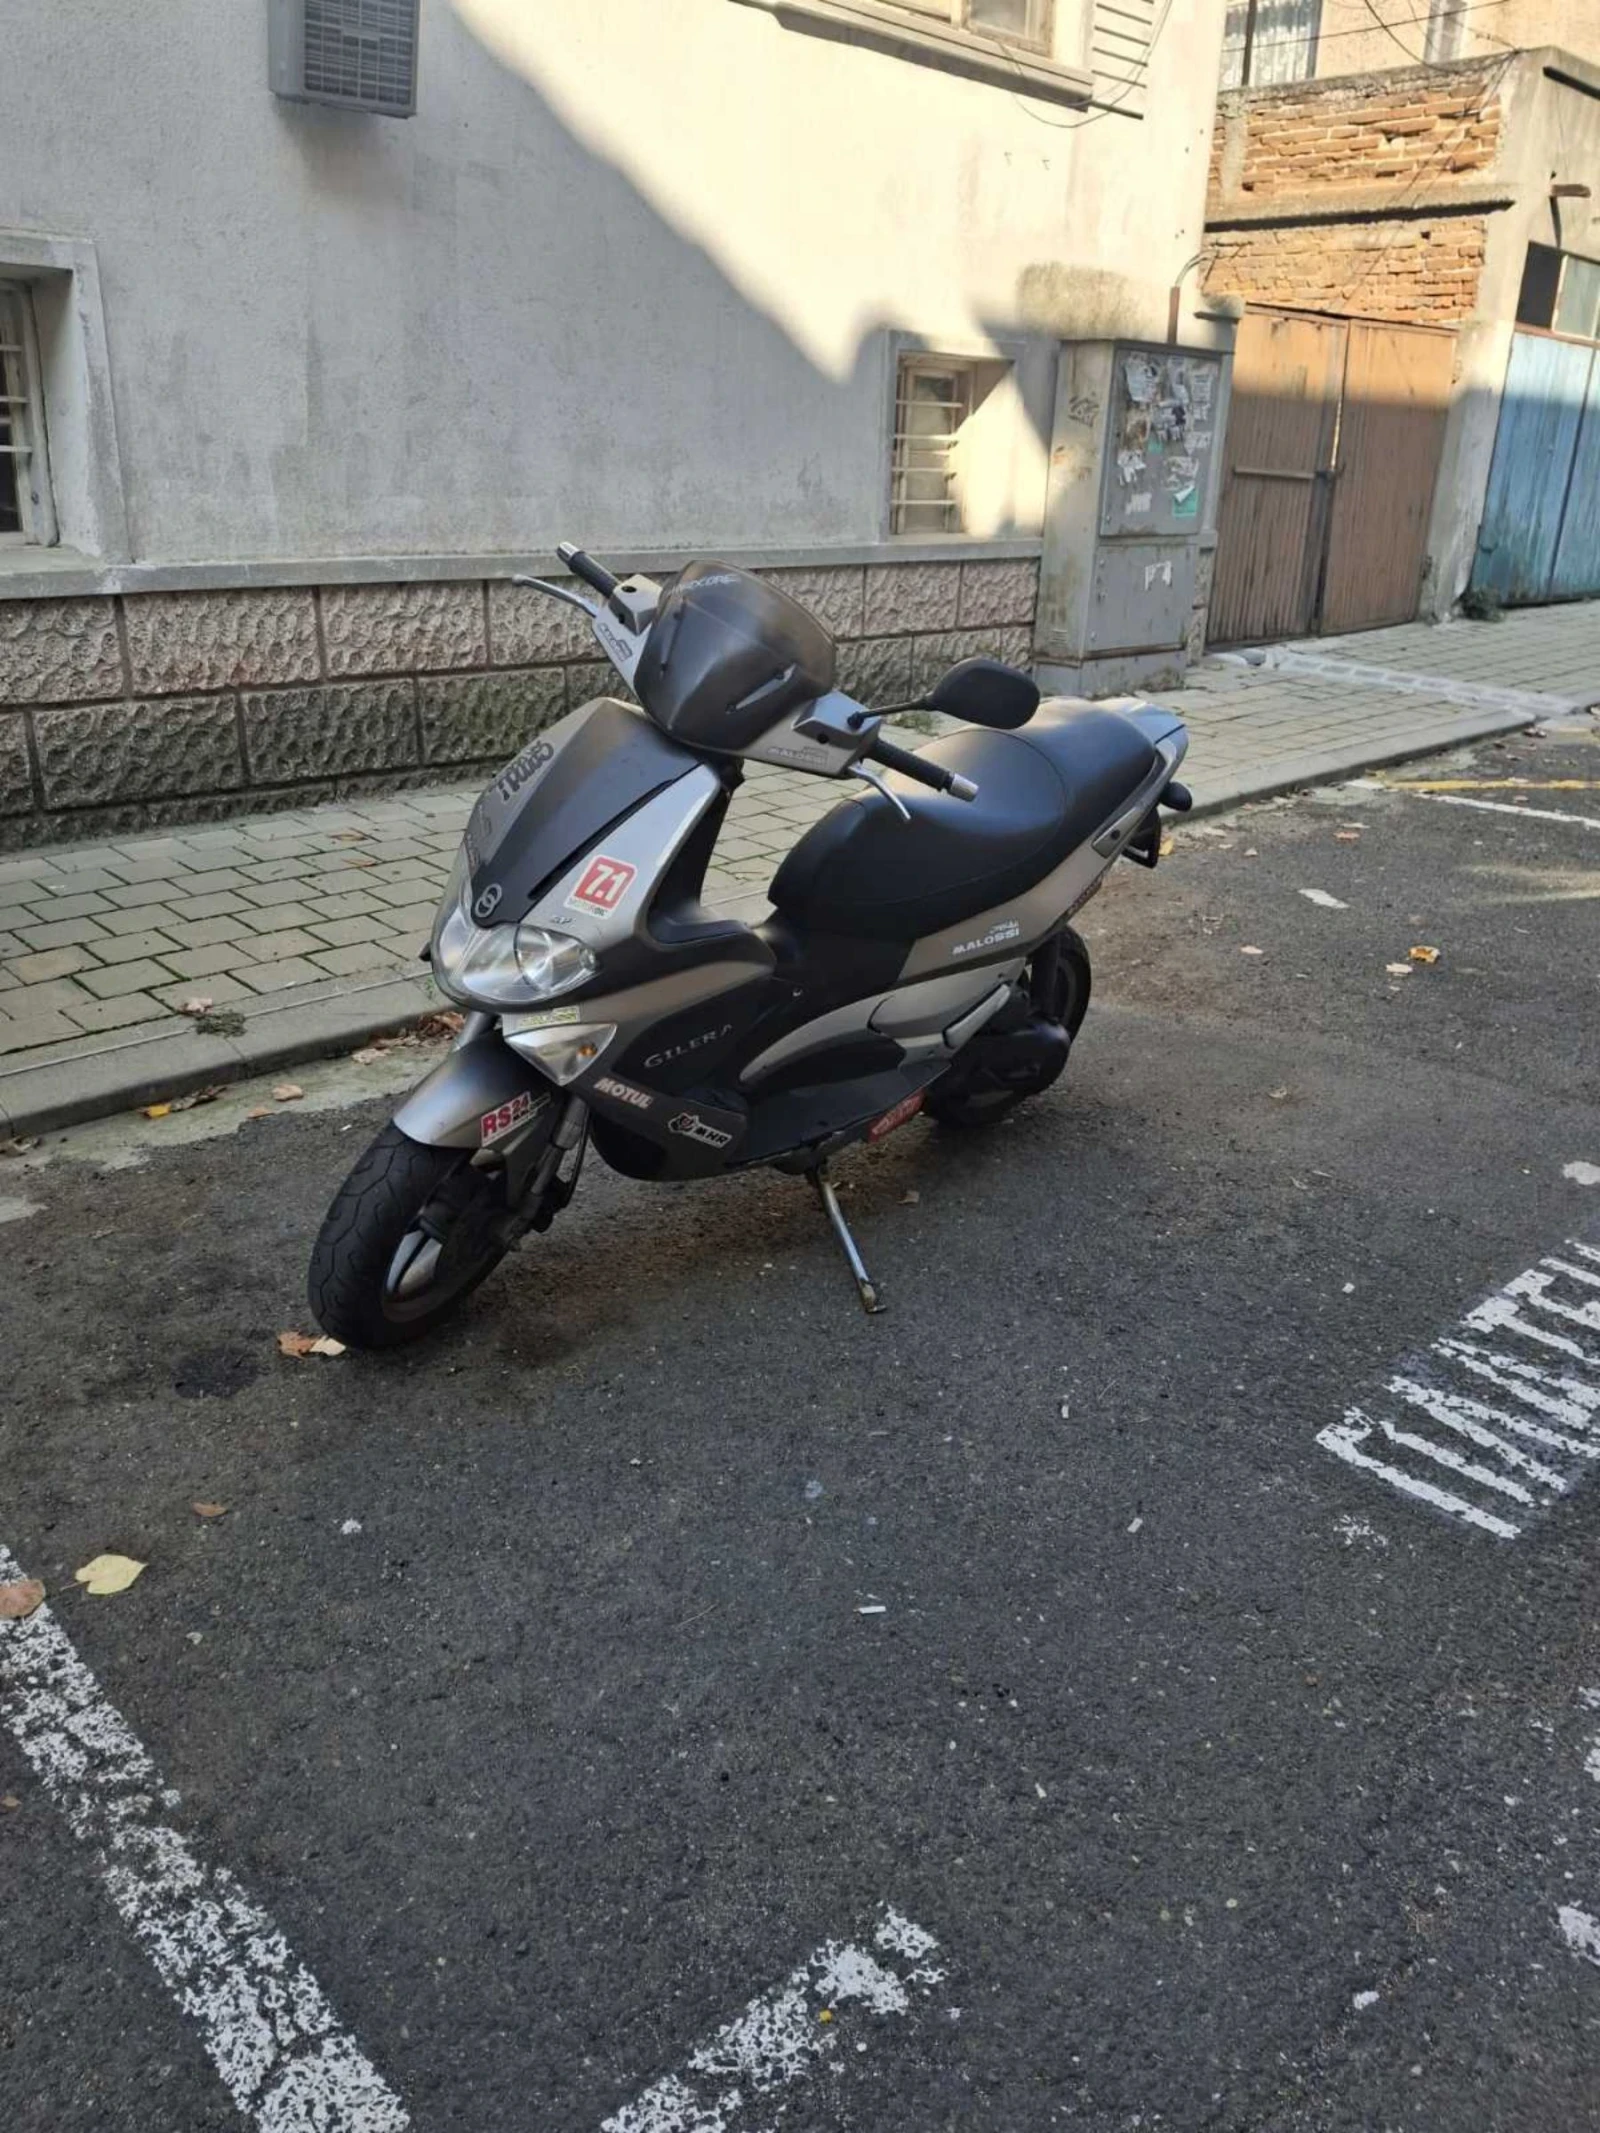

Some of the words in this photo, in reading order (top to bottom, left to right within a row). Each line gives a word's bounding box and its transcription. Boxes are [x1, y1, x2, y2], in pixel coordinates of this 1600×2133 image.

[585, 864, 628, 902] 7.1
[952, 927, 1020, 955] MALOSSI
[644, 1024, 732, 1068] GILERA
[594, 1077, 653, 1109] MOTUL
[694, 1126, 729, 1144] MHR
